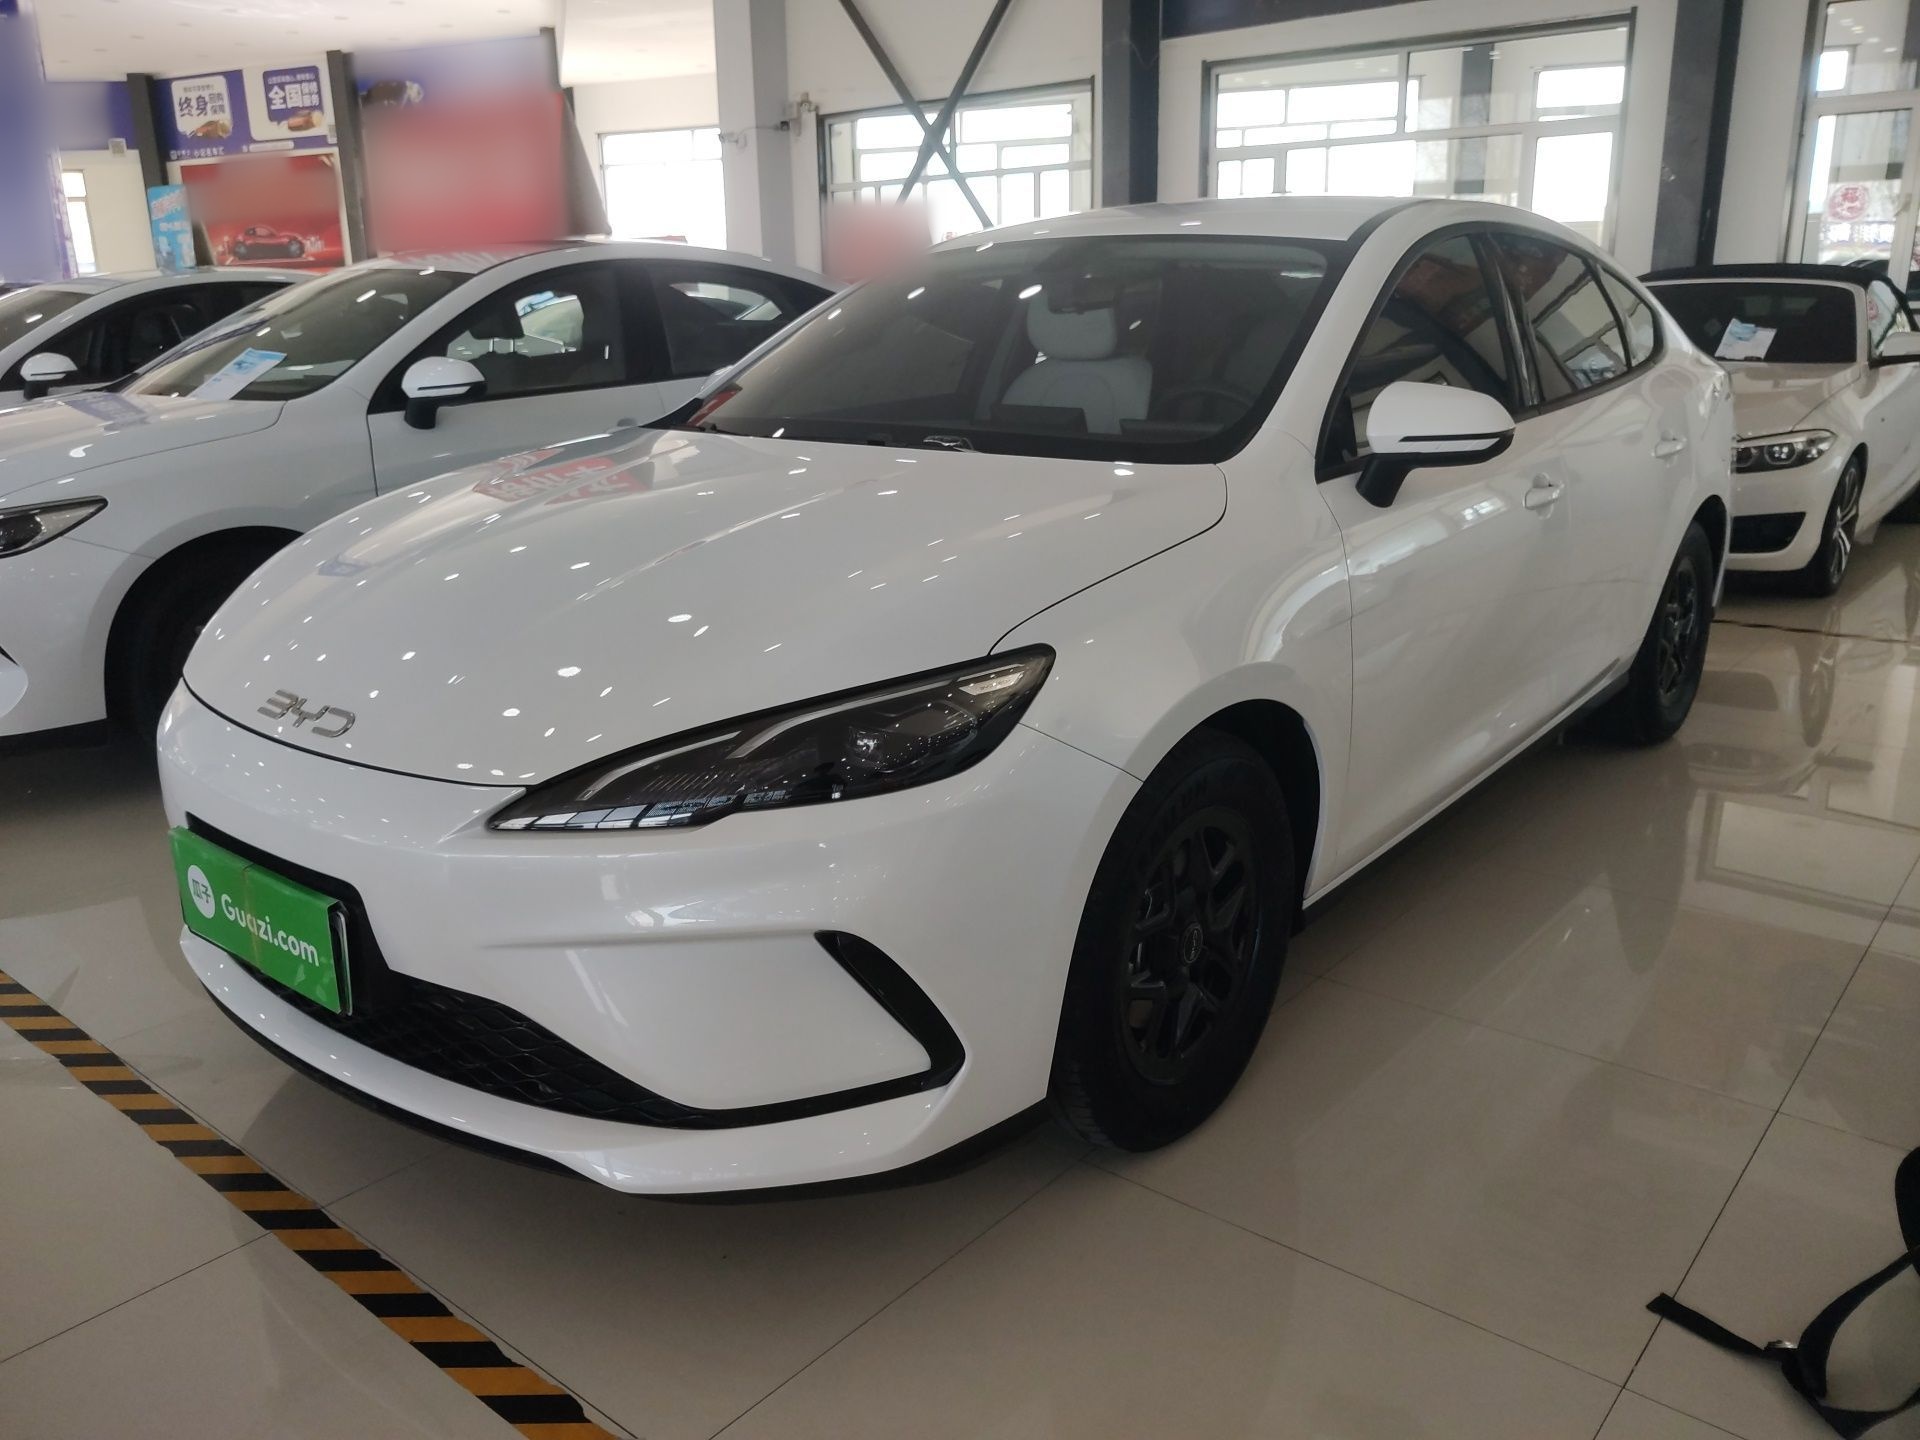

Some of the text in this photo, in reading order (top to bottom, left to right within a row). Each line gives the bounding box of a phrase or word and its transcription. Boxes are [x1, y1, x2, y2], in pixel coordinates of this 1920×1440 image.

[178, 94, 208, 117] 终身
[268, 84, 303, 110] 全国
[256, 688, 357, 738] BYD
[191, 878, 320, 967] 瓜子 Guazi.com
